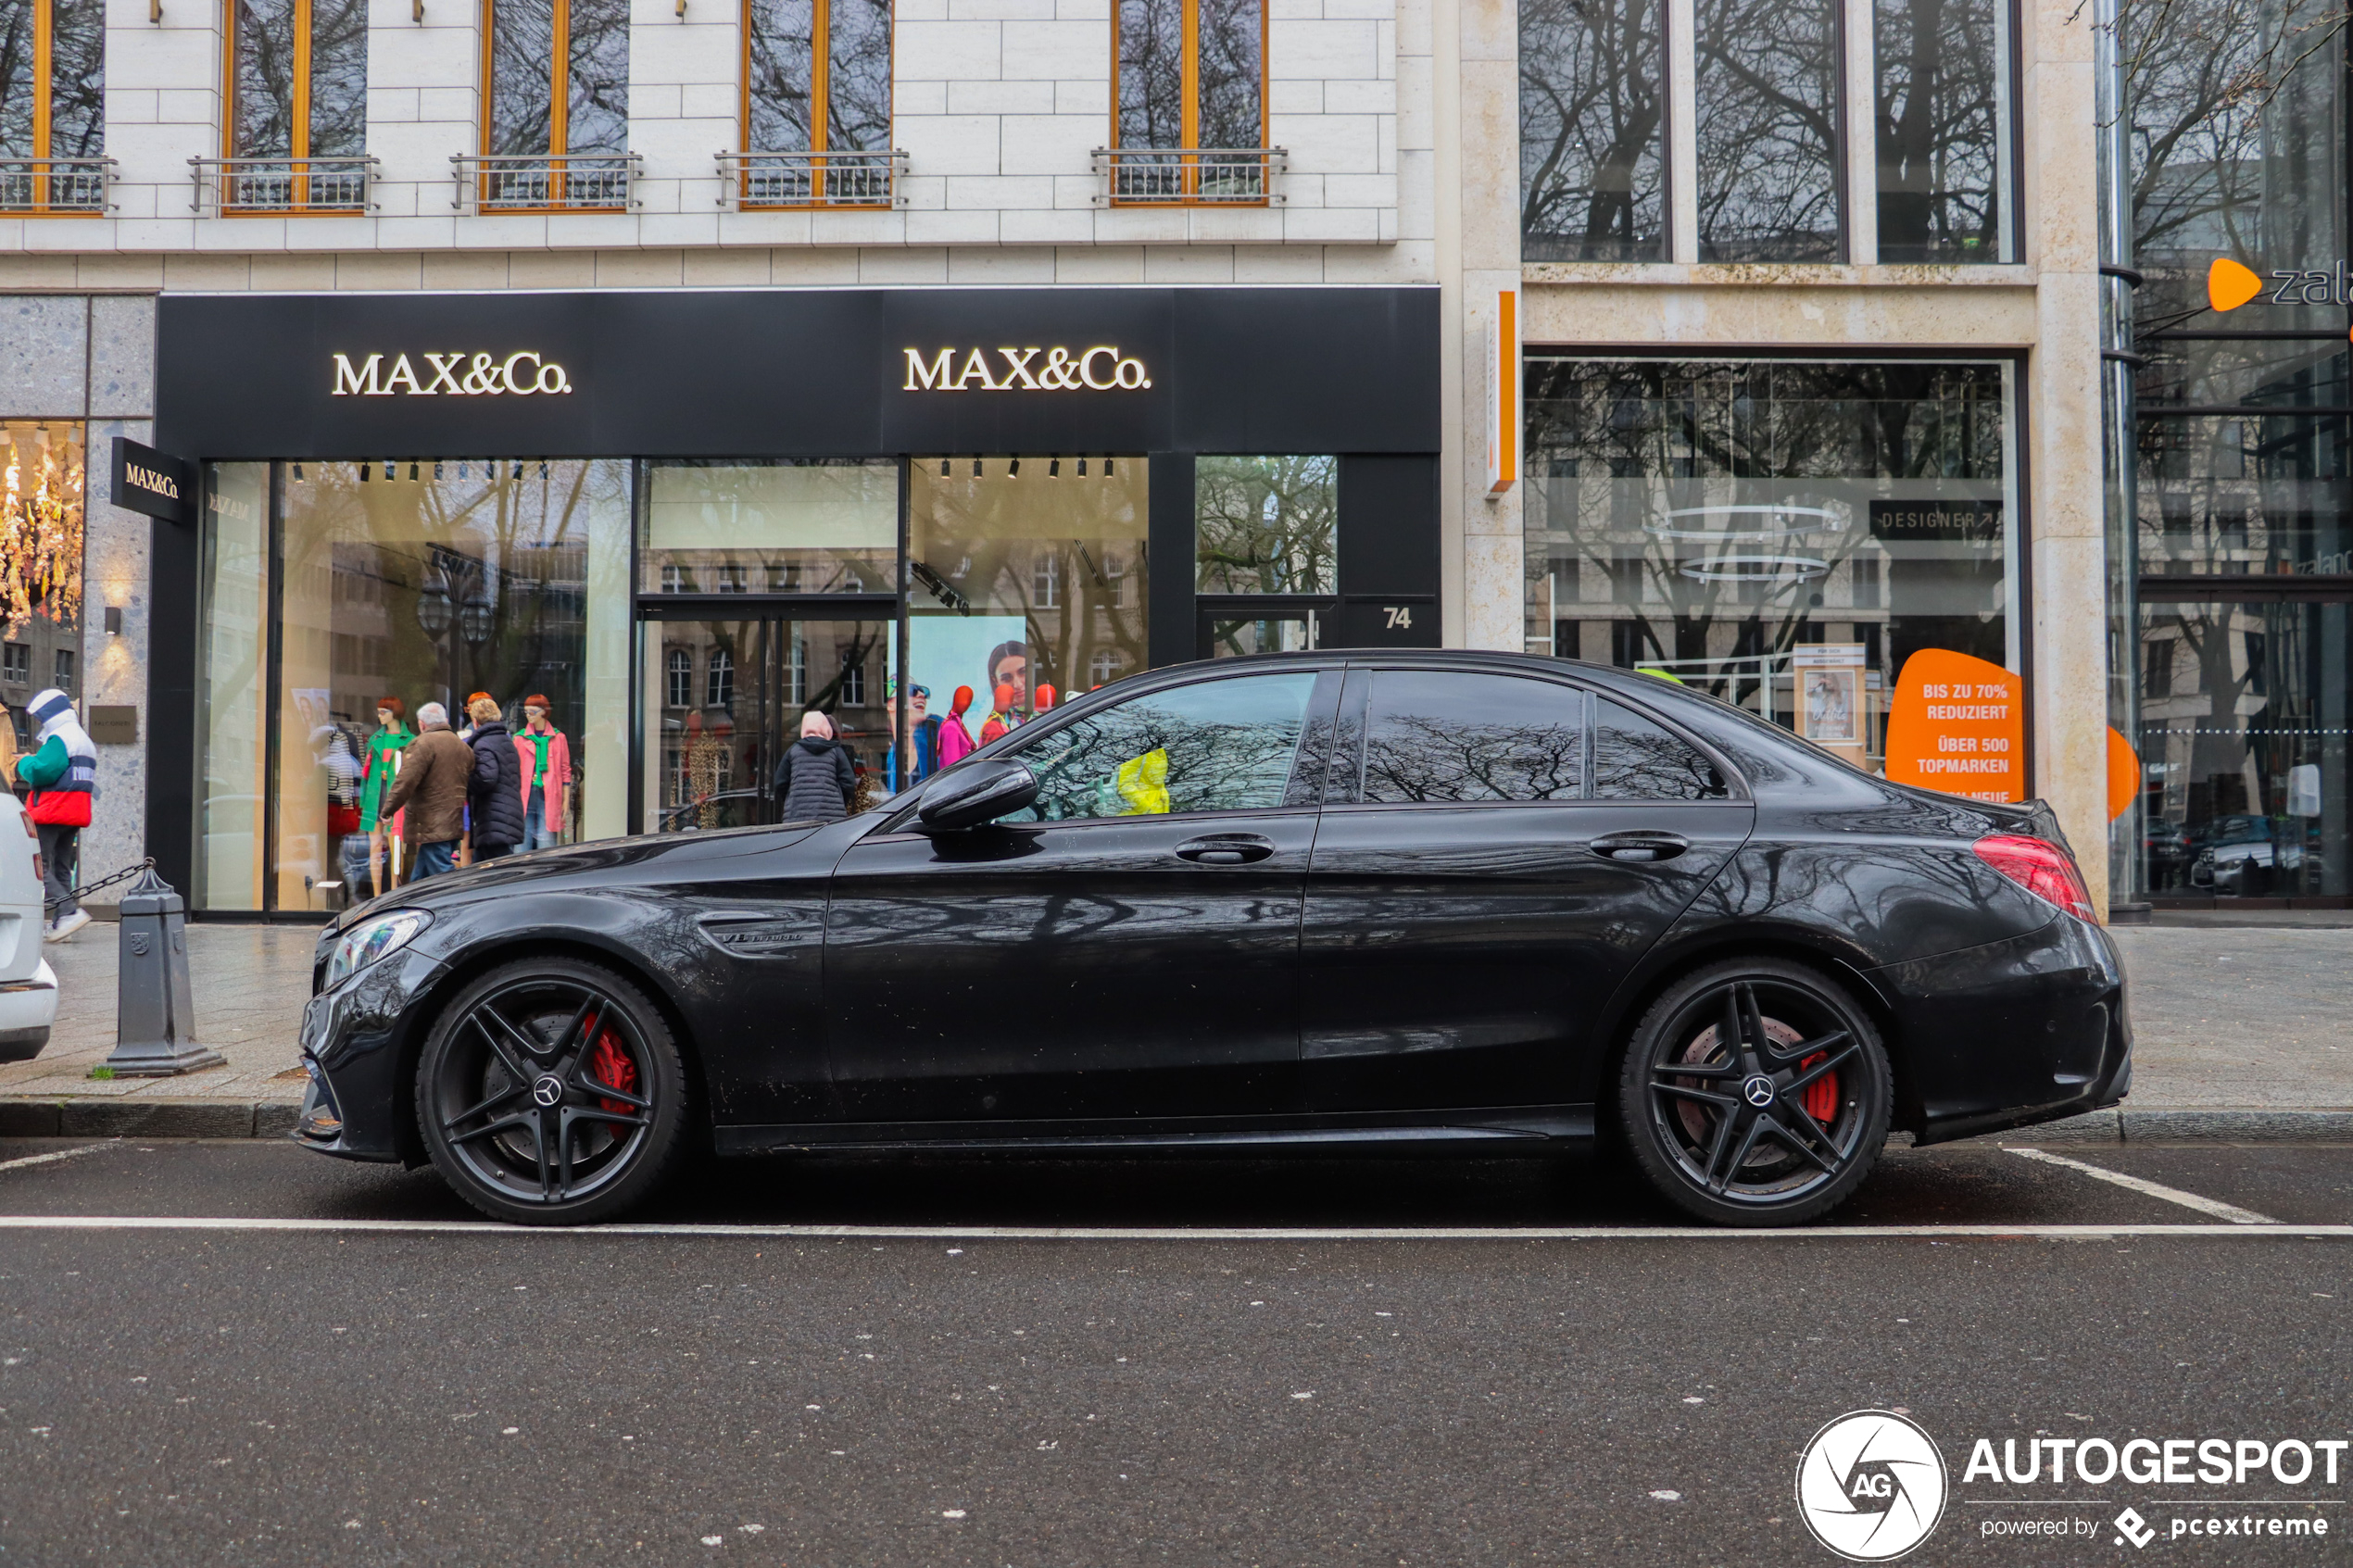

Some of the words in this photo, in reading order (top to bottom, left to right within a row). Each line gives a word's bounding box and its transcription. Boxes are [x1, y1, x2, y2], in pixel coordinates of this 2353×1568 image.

[2272, 259, 2353, 305] zal
[332, 351, 573, 395] MAX&Co.
[902, 346, 1151, 391] MAX&Co.
[126, 462, 179, 499] MAX&Co.
[1882, 512, 1975, 528] DESIGNER
[1383, 607, 1412, 629] 74
[1923, 684, 1947, 698] BIS
[1952, 684, 1971, 698] ZU
[1976, 684, 2007, 698] 70%
[1927, 705, 2008, 720] REDUZIERT
[1938, 734, 1977, 752] ÜBER
[1982, 738, 2008, 752] 500
[1917, 759, 2008, 773] TOPMARKEN
